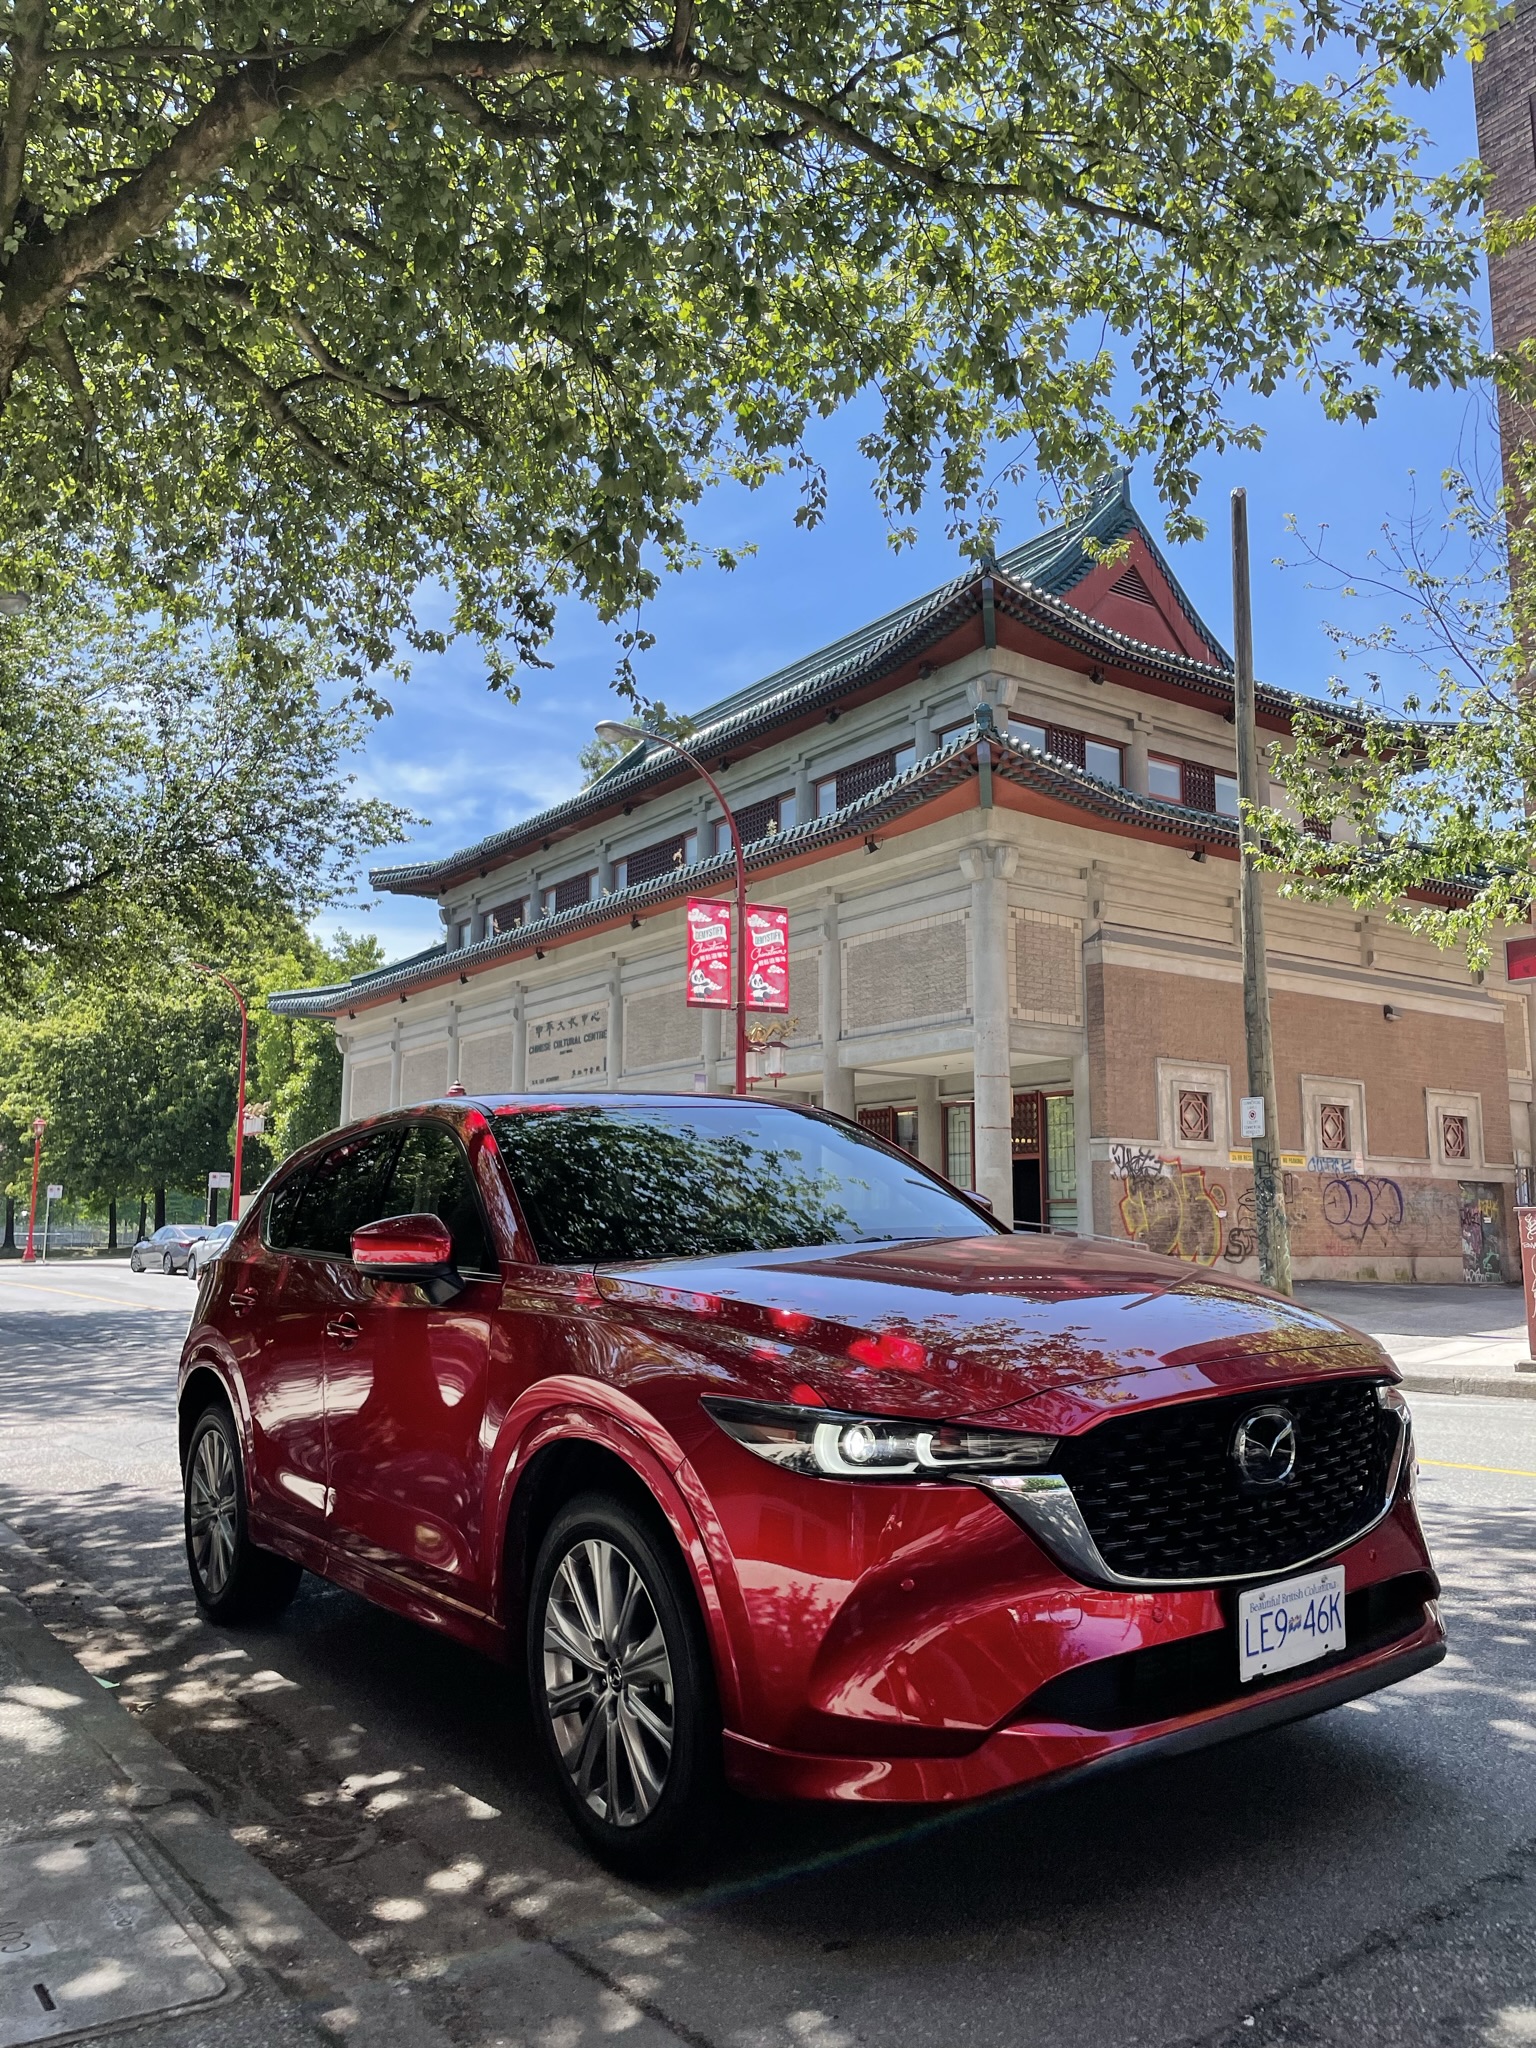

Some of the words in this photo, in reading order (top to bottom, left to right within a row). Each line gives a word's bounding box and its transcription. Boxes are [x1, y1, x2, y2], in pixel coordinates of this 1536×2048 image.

[695, 925, 723, 940] DEMYSTIFY
[755, 931, 781, 945] DEMYSTIFY
[691, 941, 728, 956] Chinatown
[750, 946, 786, 960] Chinatown
[529, 1041, 551, 1055] CHINESE
[553, 1035, 582, 1050] CULTURAL
[583, 1029, 608, 1043] CENTRE
[1249, 1594, 1280, 1613] Beautiful
[1282, 1589, 1303, 1604] British
[1304, 1581, 1337, 1596] Columbia
[1245, 1608, 1288, 1658] LE9
[1303, 1591, 1342, 1637] 46K
